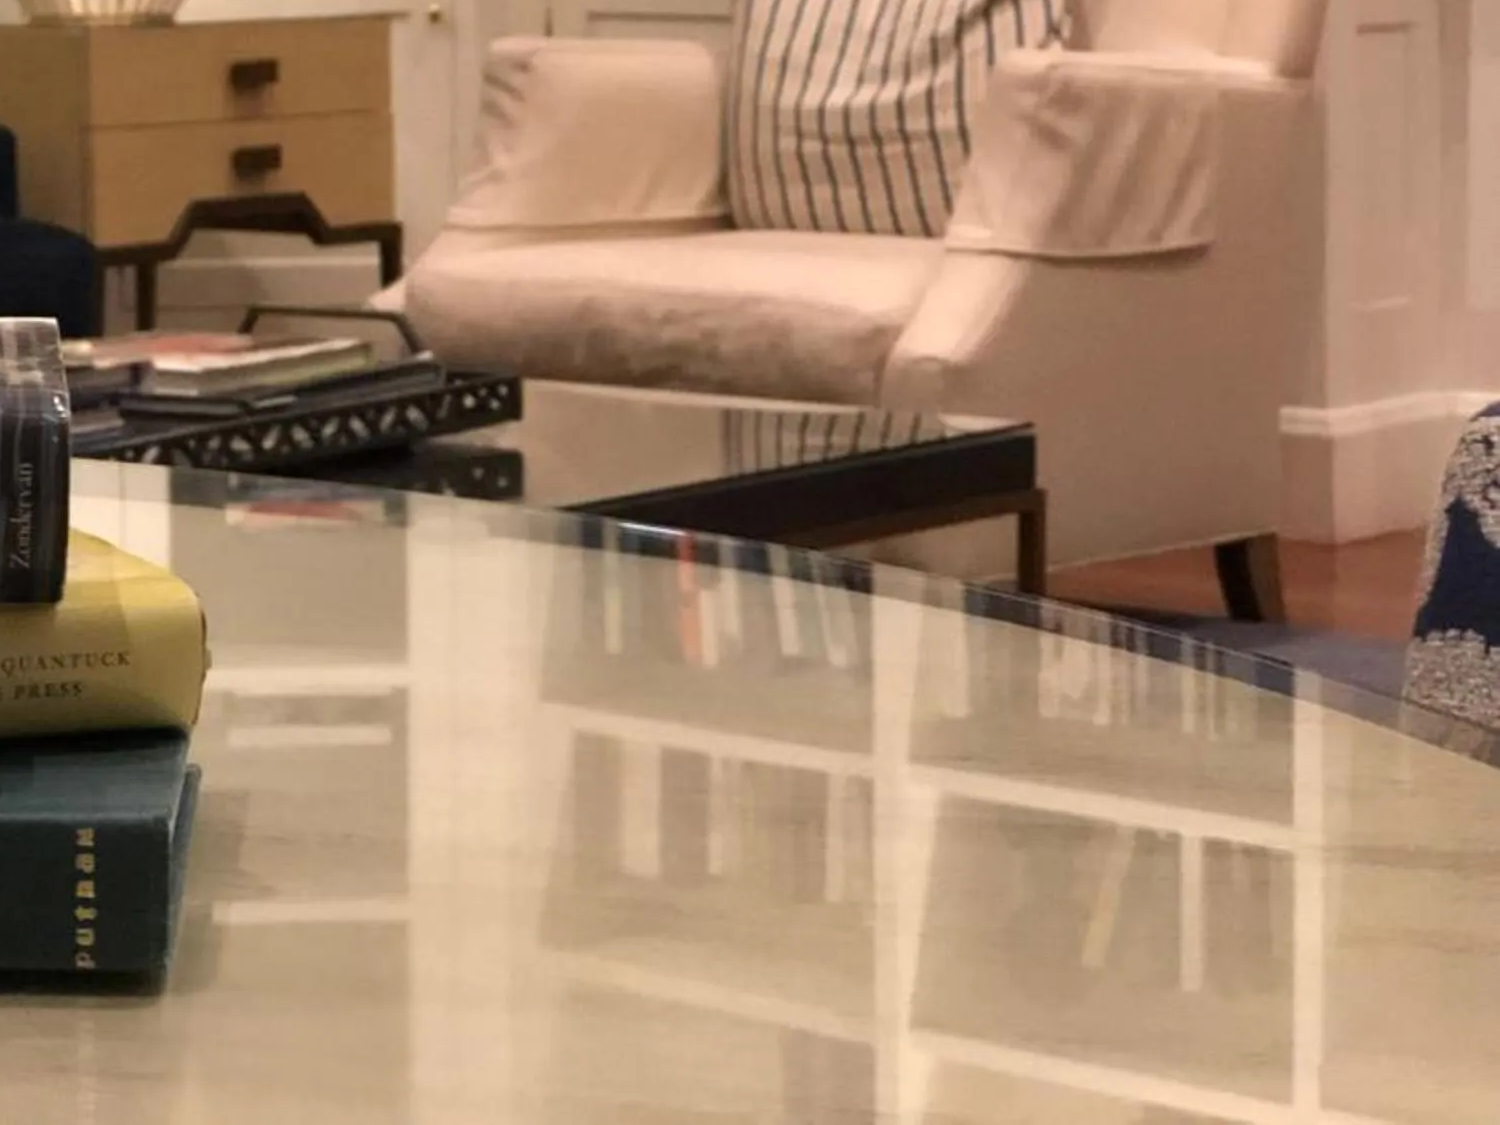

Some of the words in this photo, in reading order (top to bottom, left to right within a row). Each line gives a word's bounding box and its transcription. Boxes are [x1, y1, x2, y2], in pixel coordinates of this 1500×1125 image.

[9, 462, 34, 570] Zondervan
[0, 651, 131, 677] QUANTUCK
[13, 681, 84, 701] PRESS
